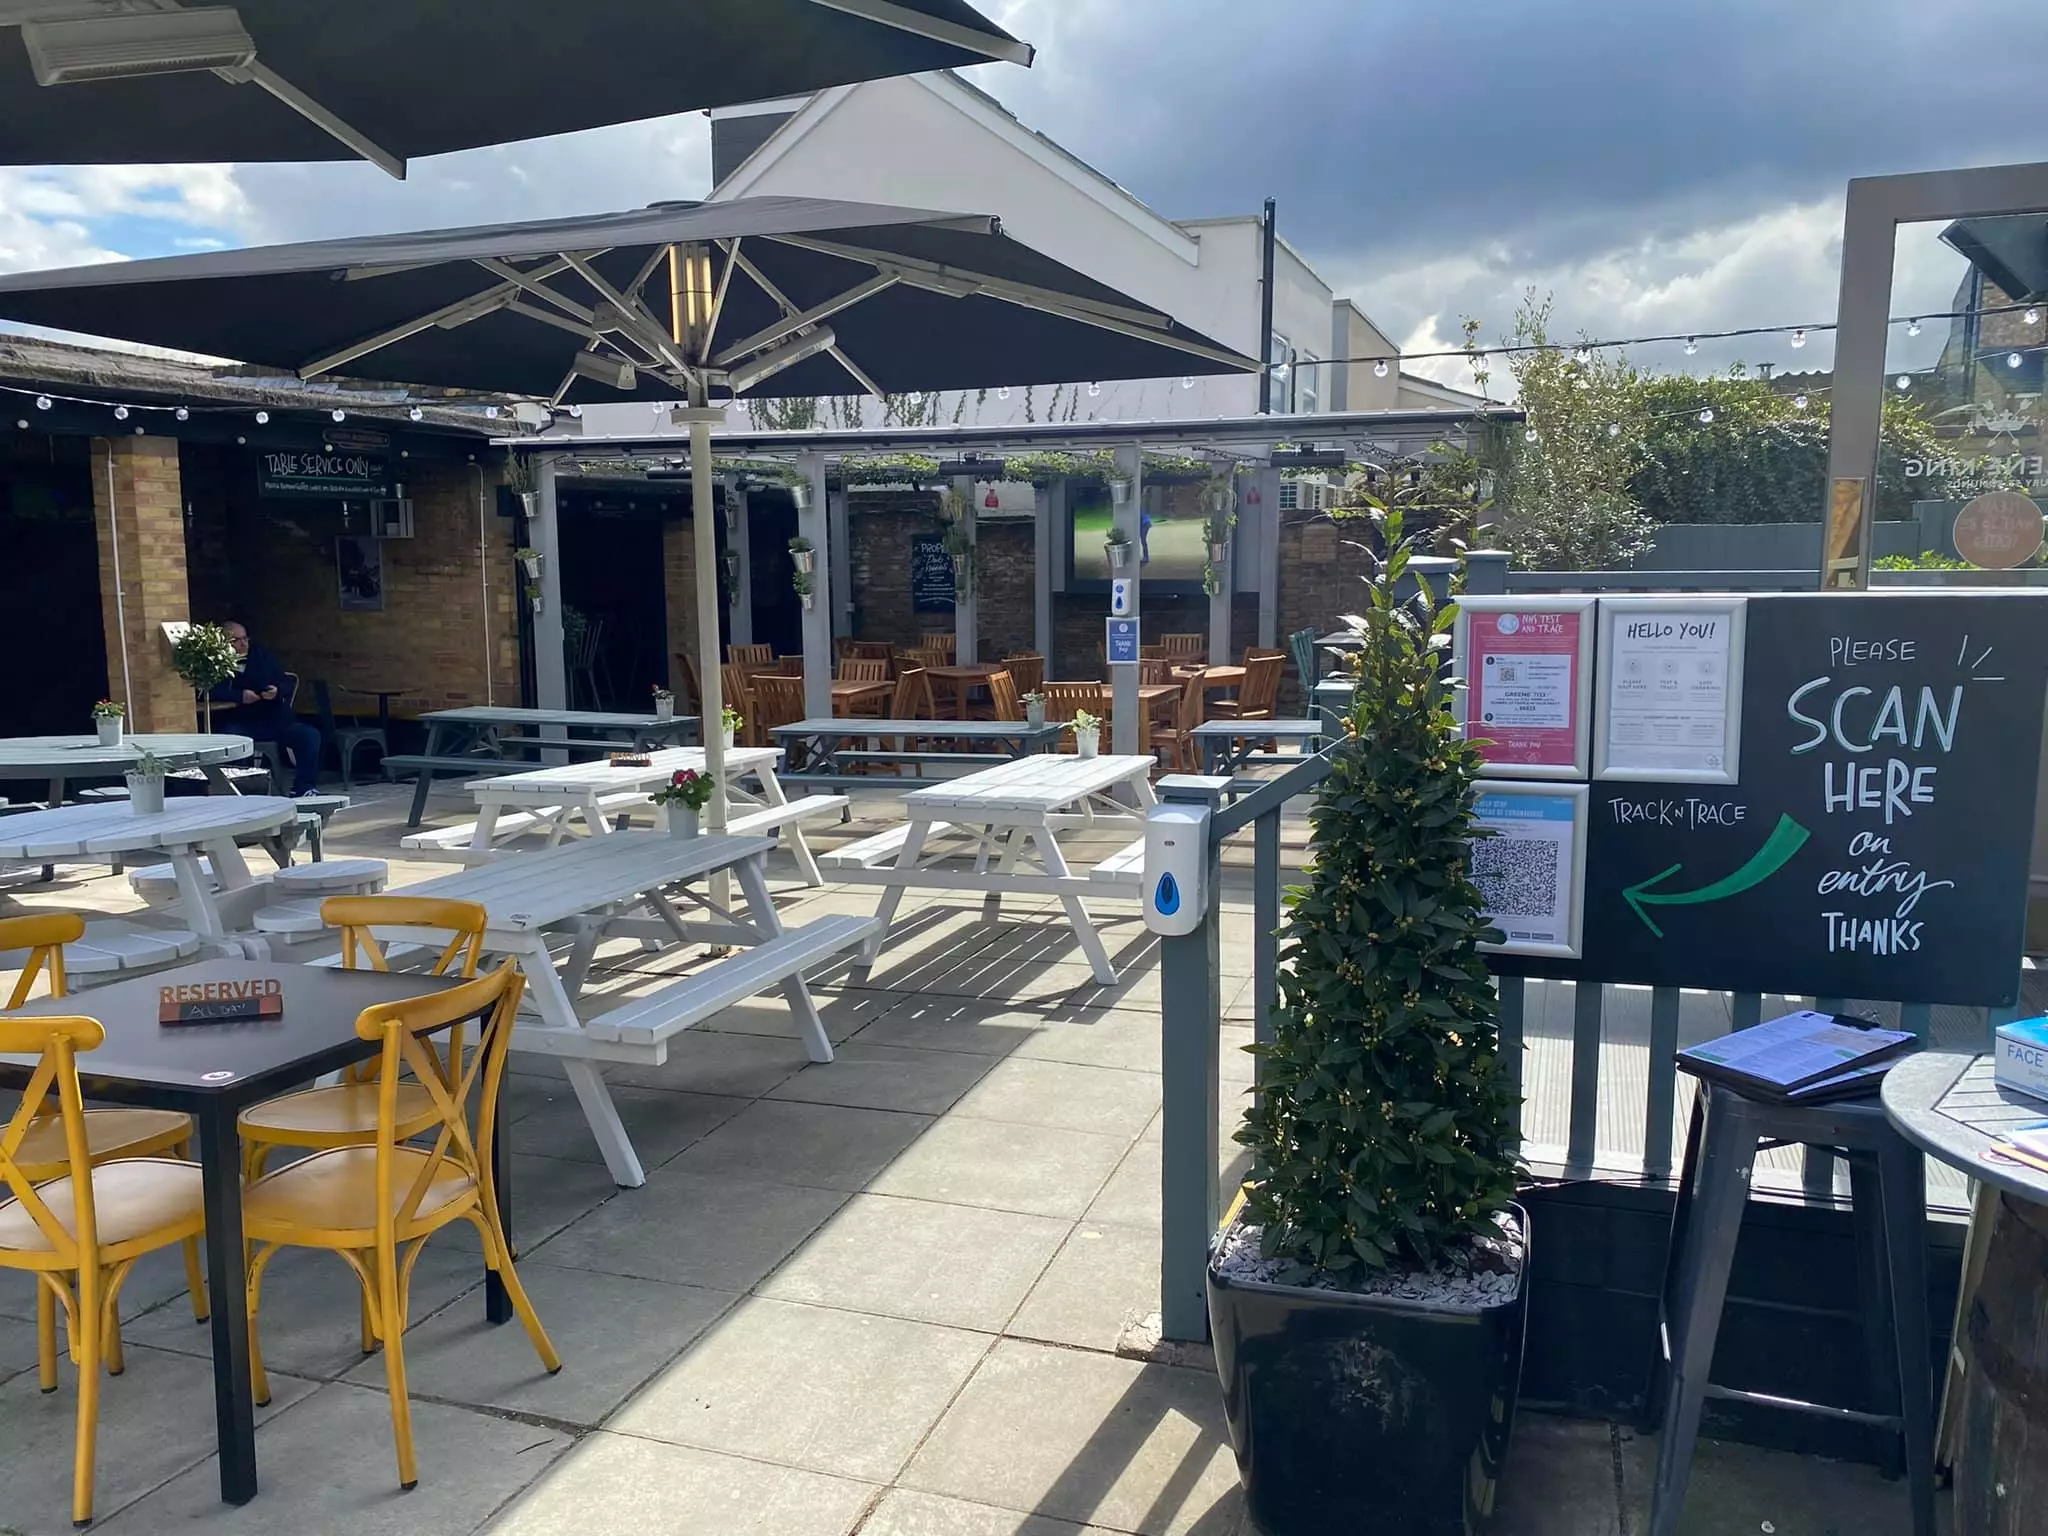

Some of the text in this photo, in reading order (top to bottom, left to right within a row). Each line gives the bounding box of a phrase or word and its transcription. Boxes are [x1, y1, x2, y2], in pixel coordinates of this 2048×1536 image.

[264, 452, 369, 479] TABLE SERVICE ONLY
[1521, 614, 1562, 625] NHS TEST
[1538, 624, 1564, 634] TRACE
[1627, 621, 1715, 640] HELLO YOU!
[1830, 635, 1917, 667] PLEASE
[1787, 676, 1963, 755] SCAN
[1824, 758, 1938, 825] HERE
[1607, 797, 1674, 826] TRACK
[1685, 798, 1747, 830] TRACE
[1849, 831, 1892, 856] on
[1817, 858, 1955, 919] entry
[1821, 912, 1925, 955] THANKS
[159, 978, 282, 1004] RESERVED
[2007, 1043, 2044, 1068] FACE
